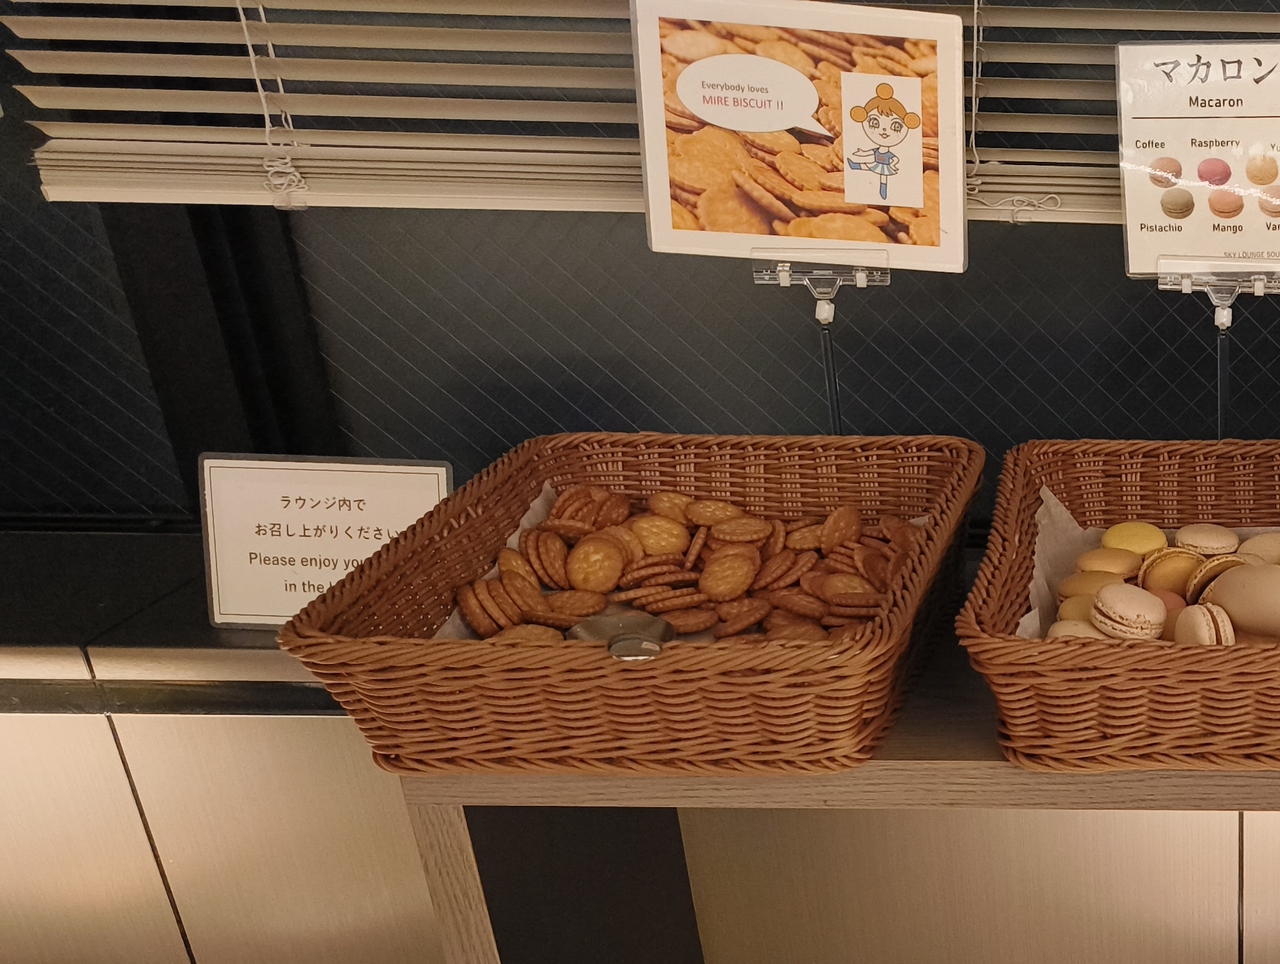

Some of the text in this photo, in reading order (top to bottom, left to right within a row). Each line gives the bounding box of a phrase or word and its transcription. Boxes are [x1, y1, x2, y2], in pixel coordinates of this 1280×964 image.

[1154, 54, 1278, 84] マカロン
[702, 81, 769, 94] Everybody loves
[702, 95, 729, 106] MIRE
[732, 97, 772, 110] BISCUIT
[1189, 96, 1243, 108] Macaron
[1135, 140, 1166, 148] Coffee
[1190, 138, 1240, 149] Raspberry
[1140, 223, 1182, 232] Pistachio
[1212, 224, 1243, 234] Mango
[281, 496, 366, 511] ラウンジ内で
[255, 523, 400, 540] お召し上がりください
[249, 552, 363, 570] Please enjoy yo
[284, 580, 296, 592] in
[302, 580, 324, 593] the
